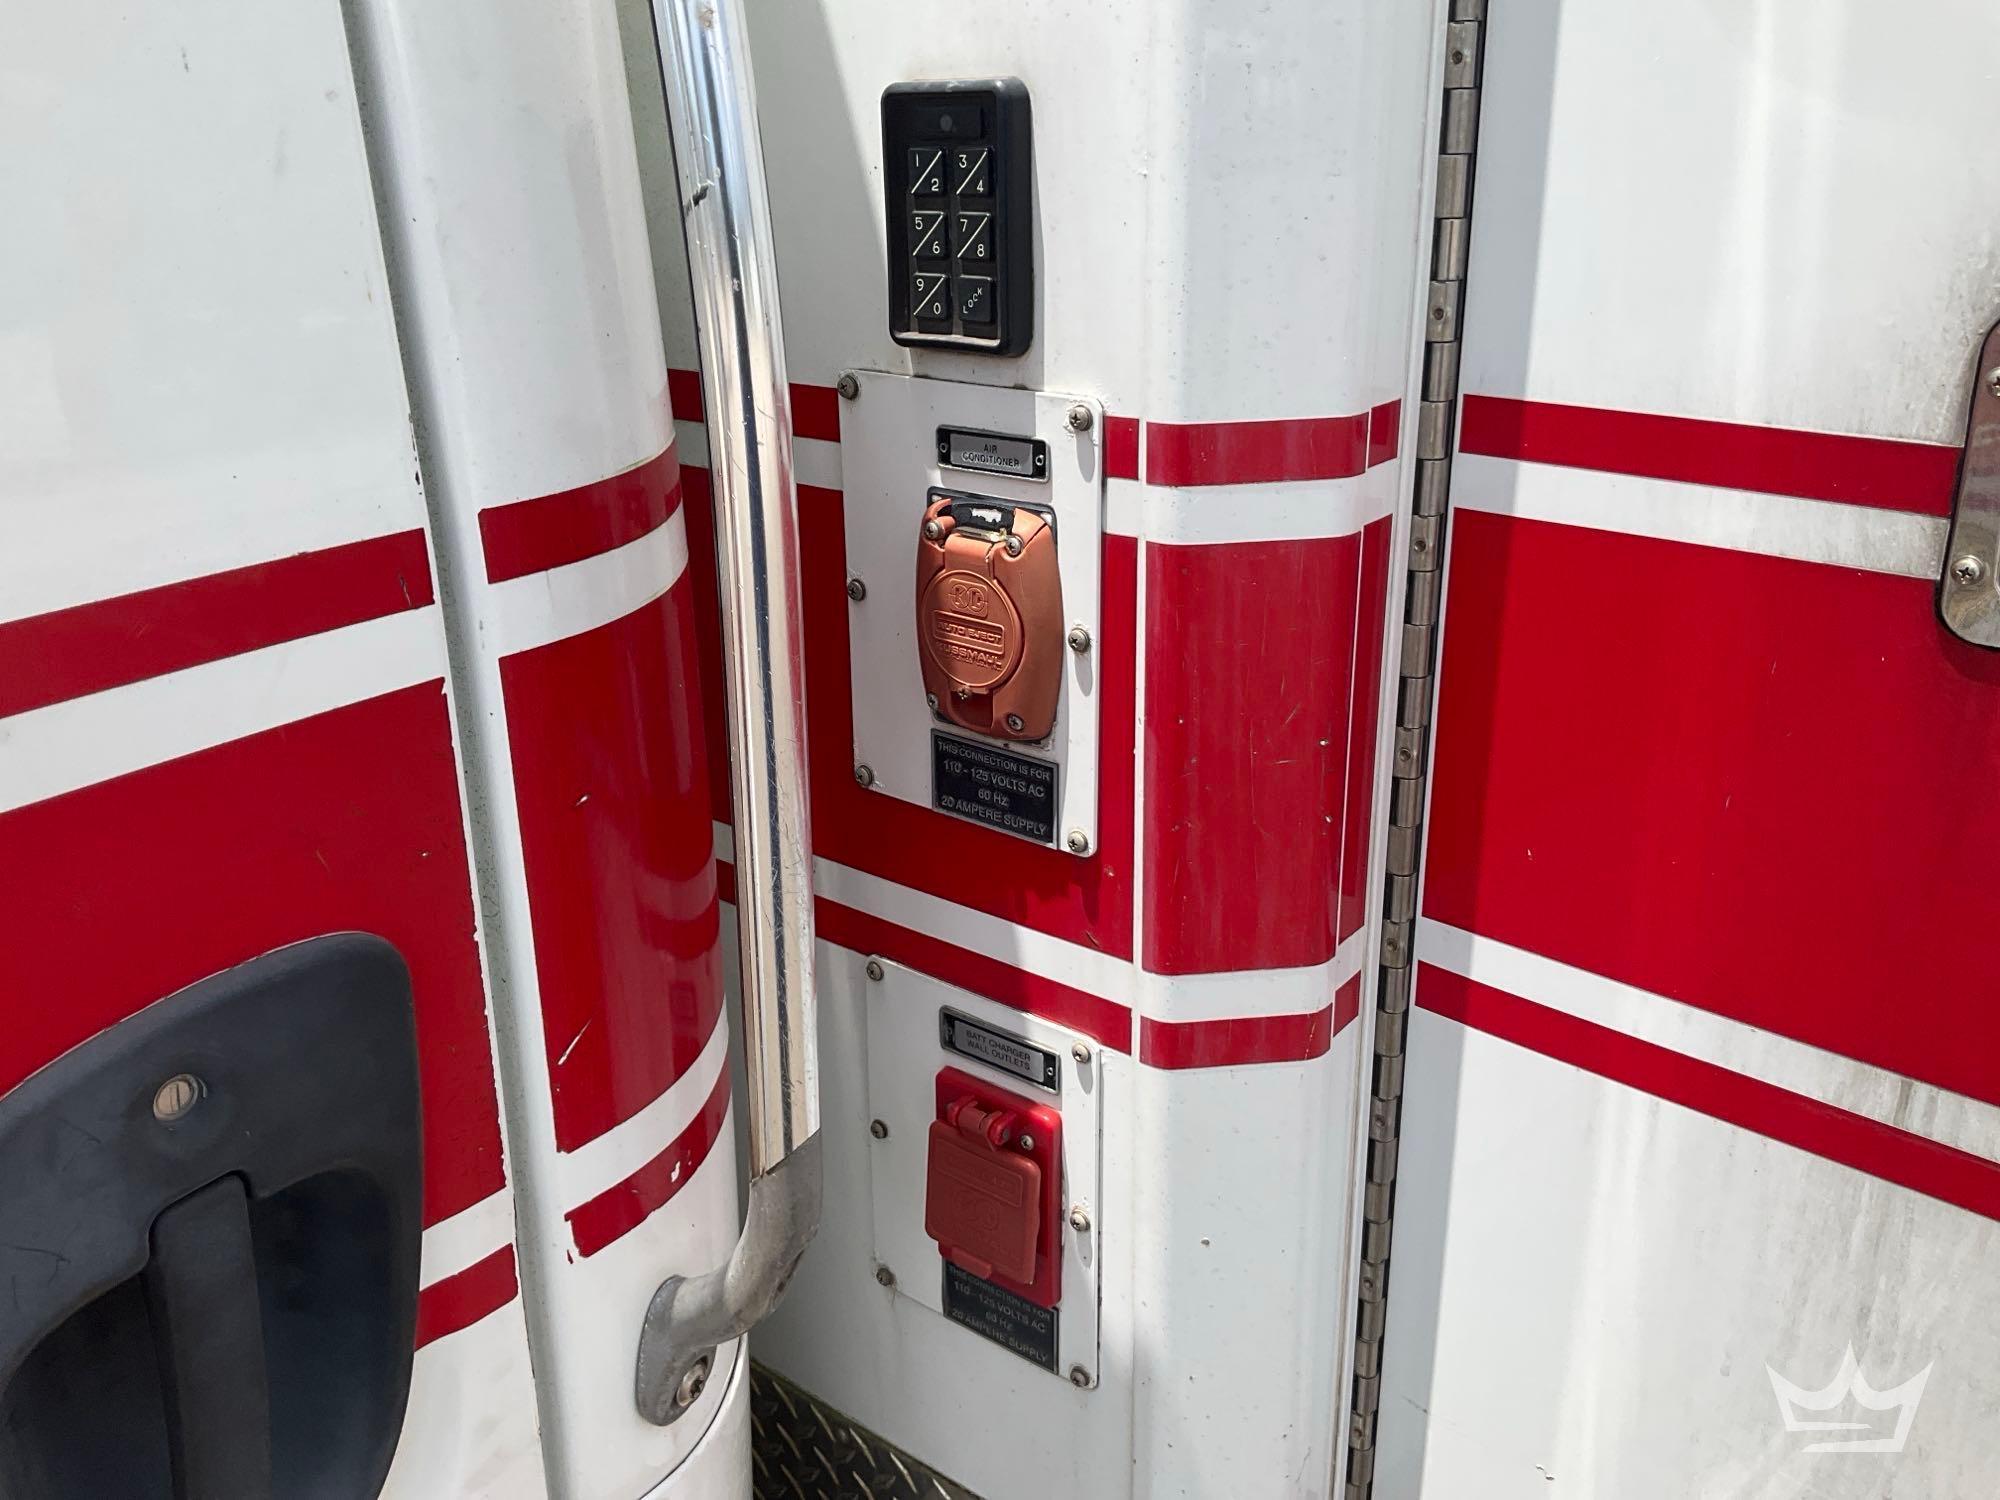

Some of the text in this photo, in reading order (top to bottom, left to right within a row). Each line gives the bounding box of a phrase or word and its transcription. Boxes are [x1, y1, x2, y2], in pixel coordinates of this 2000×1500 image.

[962, 287, 983, 314] LOCK
[961, 451, 1020, 467] CONDITIONER
[983, 443, 998, 454] AIR
[968, 628, 1002, 644] EJECT
[937, 739, 1050, 781] THIS CONNECTION IS FOR
[944, 760, 961, 773] 110
[971, 768, 989, 781] 125
[990, 772, 1027, 793] VOLTS
[1027, 784, 1045, 798] AC
[978, 788, 991, 800] 60
[941, 794, 1048, 836] 20 AMPERE SUPPLY
[966, 1030, 1031, 1062] BATT CHARGER
[967, 1039, 1031, 1071] WALL OUTLETS
